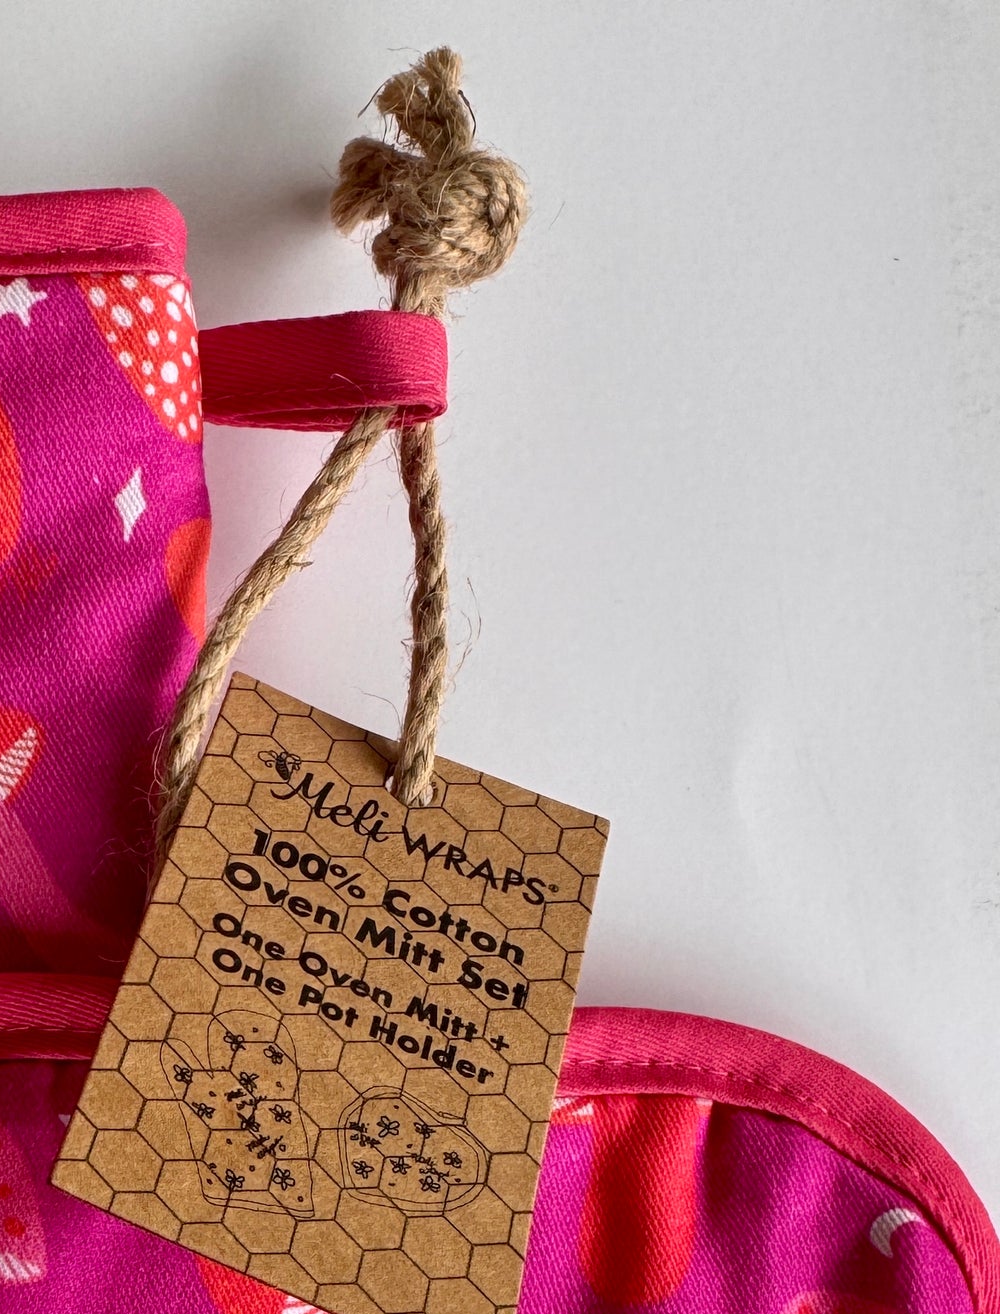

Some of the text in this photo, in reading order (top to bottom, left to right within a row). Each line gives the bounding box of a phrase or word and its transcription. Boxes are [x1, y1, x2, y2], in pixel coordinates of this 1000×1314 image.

[270, 772, 390, 843] Meli
[225, 861, 528, 1010] Oven Mitt Set
[252, 828, 525, 966] 100% Cotton
[212, 912, 510, 1051] One Oven Mitt +
[212, 948, 495, 1085] One Pot Holder
